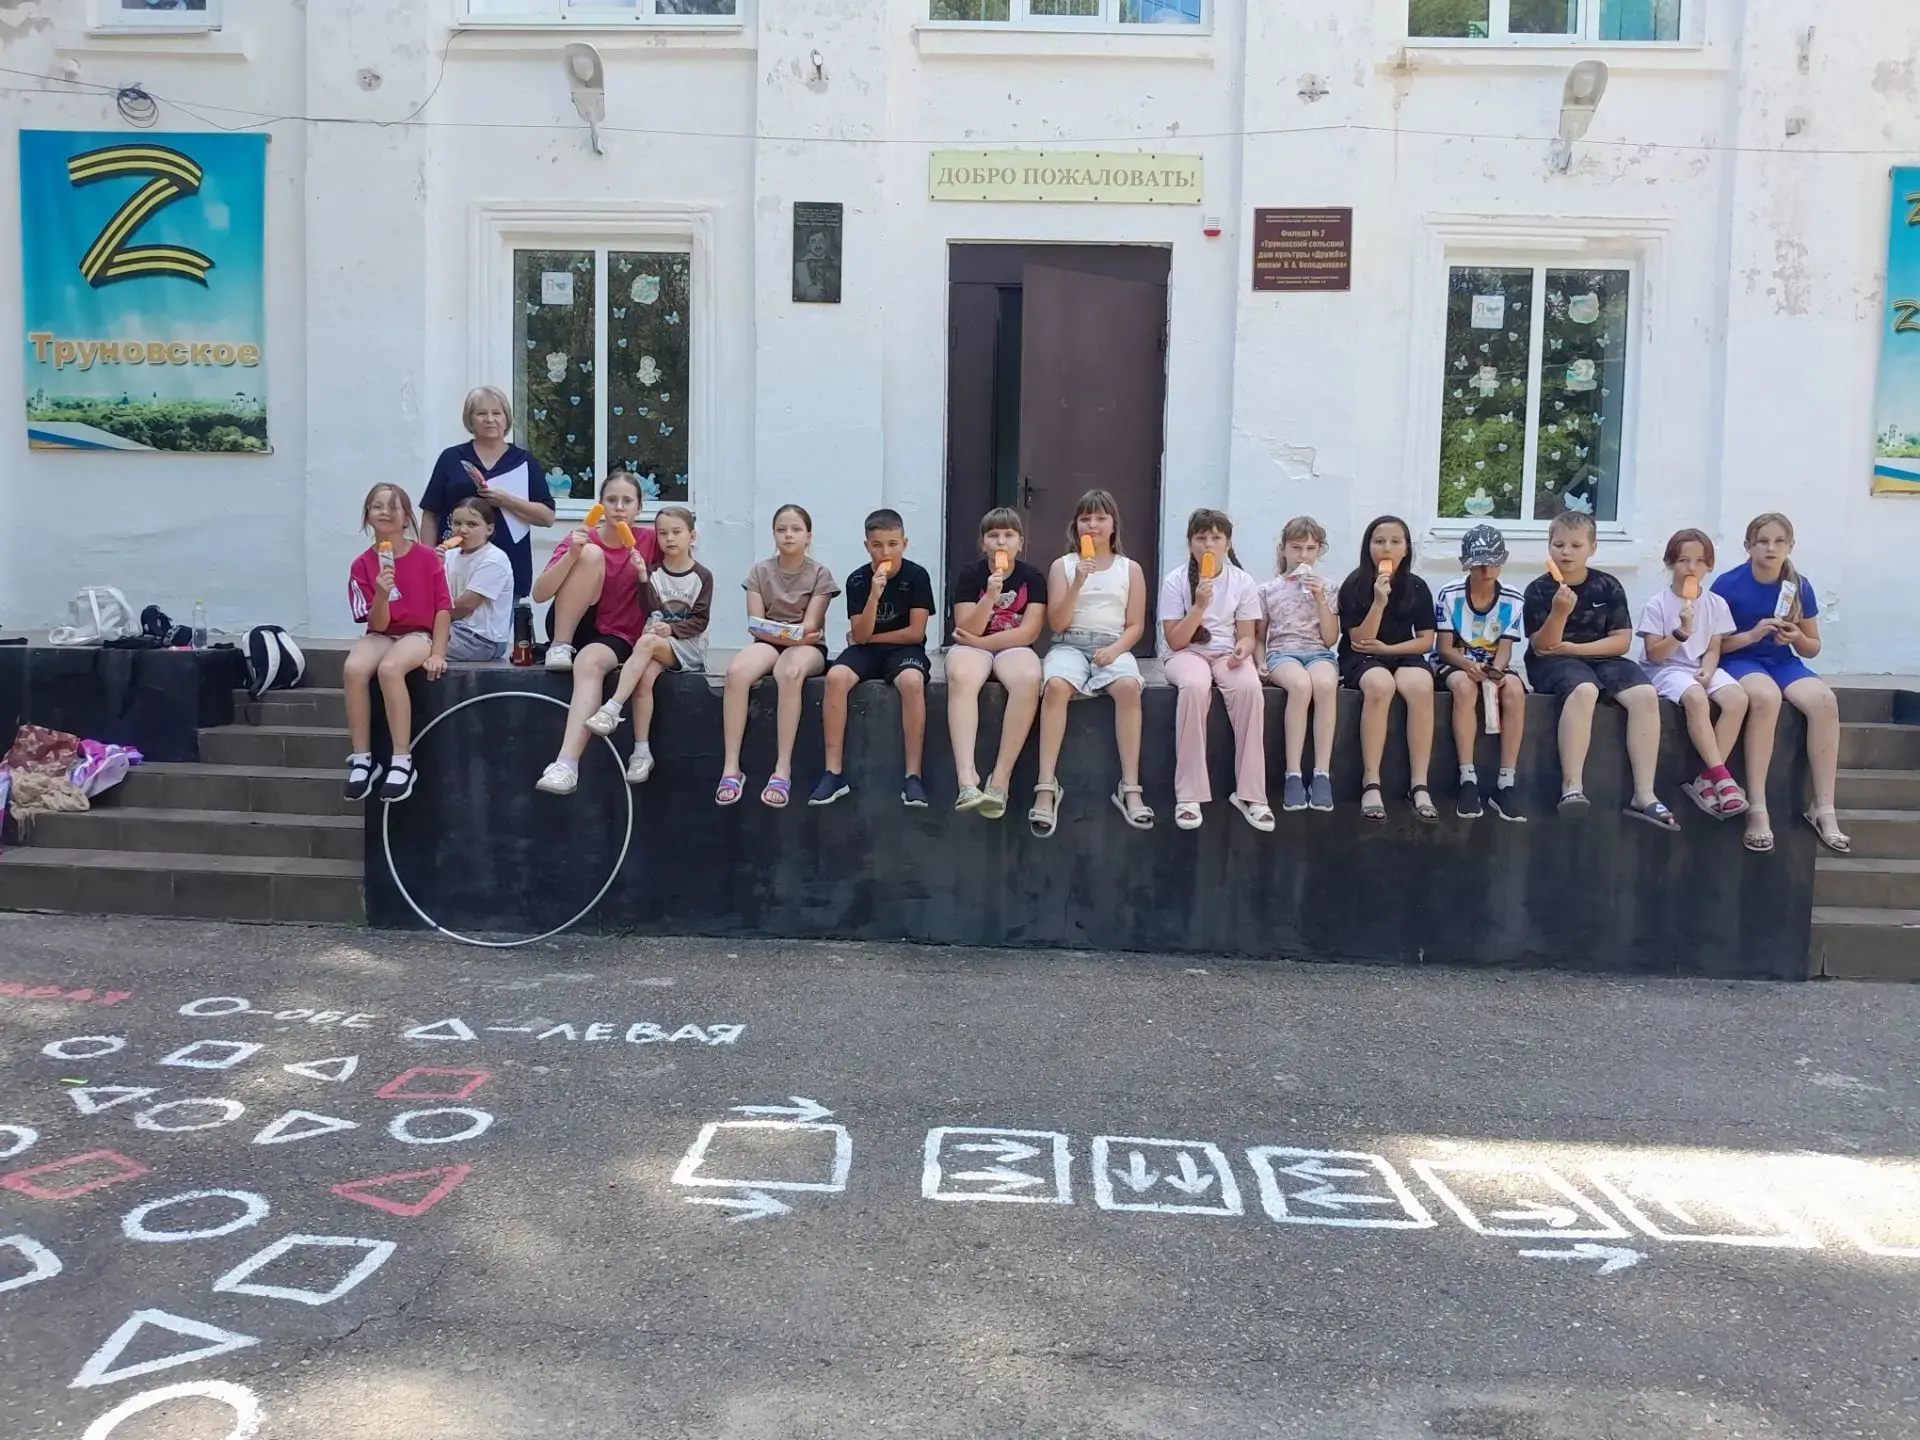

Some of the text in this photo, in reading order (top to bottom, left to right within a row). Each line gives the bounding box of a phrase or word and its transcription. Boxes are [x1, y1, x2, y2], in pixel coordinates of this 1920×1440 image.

[937, 166, 1196, 189] ДОБРО ПОЖАЛОВАТЬ!
[67, 143, 216, 289] Z
[1281, 230, 1310, 238] Филиал
[1309, 241, 1344, 249] сельский
[1258, 252, 1273, 260] дом
[1275, 252, 1310, 260] культуры
[29, 332, 261, 371] Труновское
[536, 1021, 748, 1046] ЛЕВАЯ
